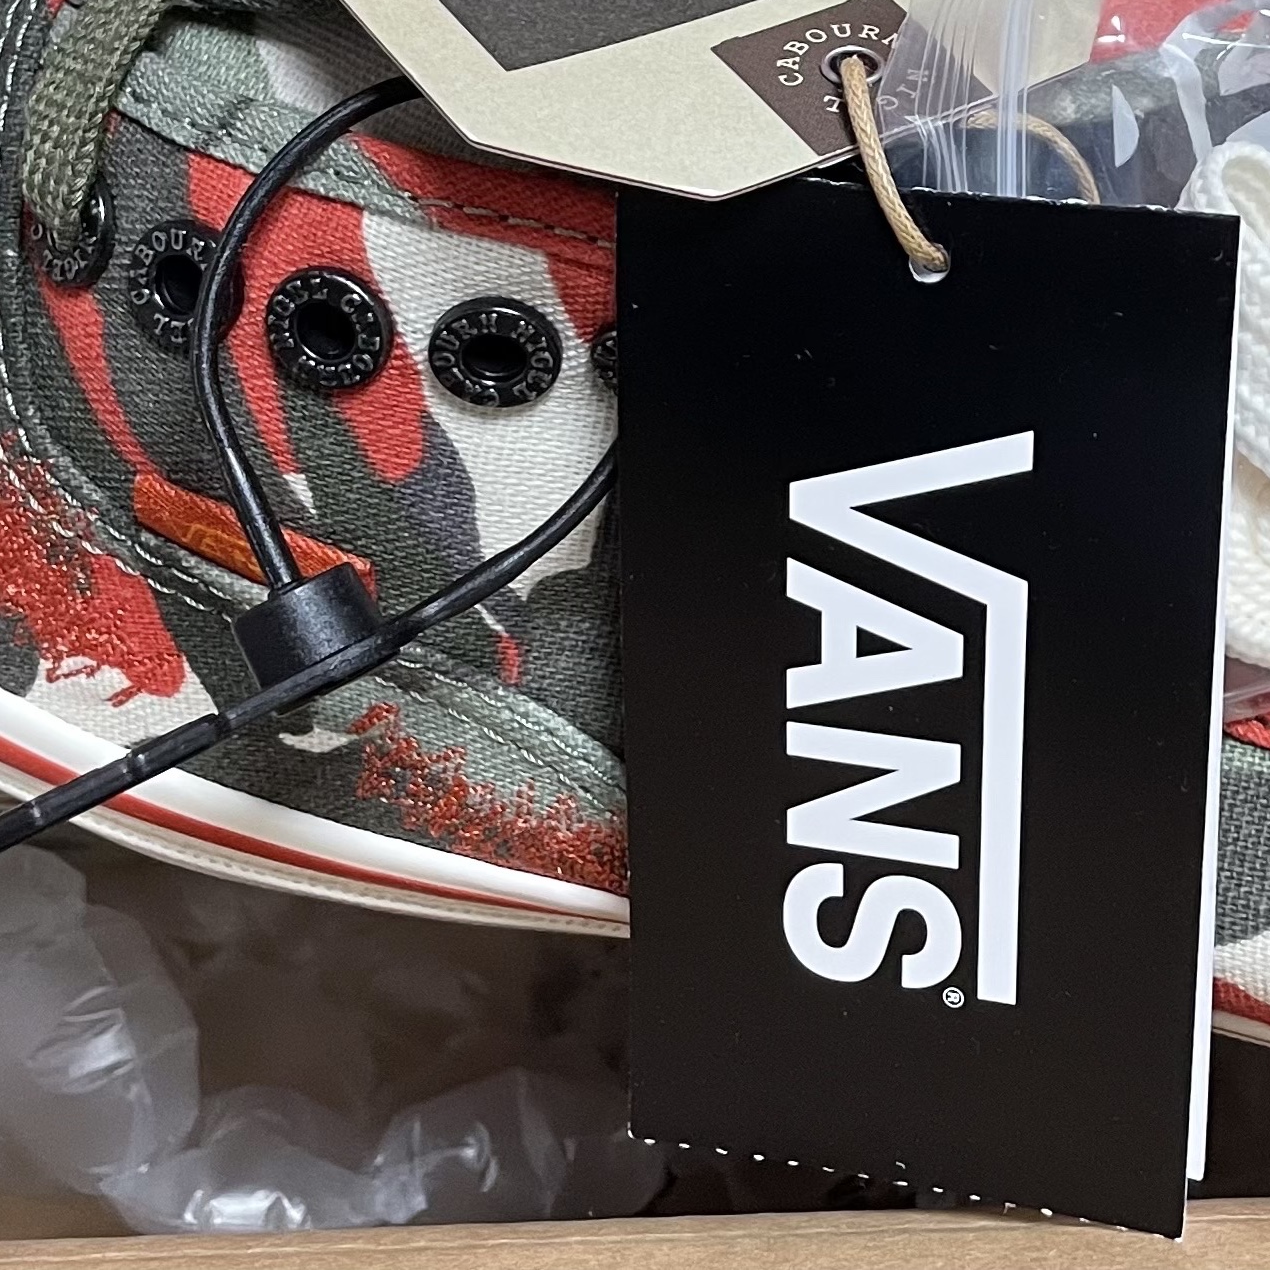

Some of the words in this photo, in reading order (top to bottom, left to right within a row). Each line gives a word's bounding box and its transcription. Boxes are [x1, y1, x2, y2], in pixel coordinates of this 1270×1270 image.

[823, 68, 929, 113] NIGL
[130, 228, 216, 306] CABOUR
[782, 430, 1035, 1006] VANS
